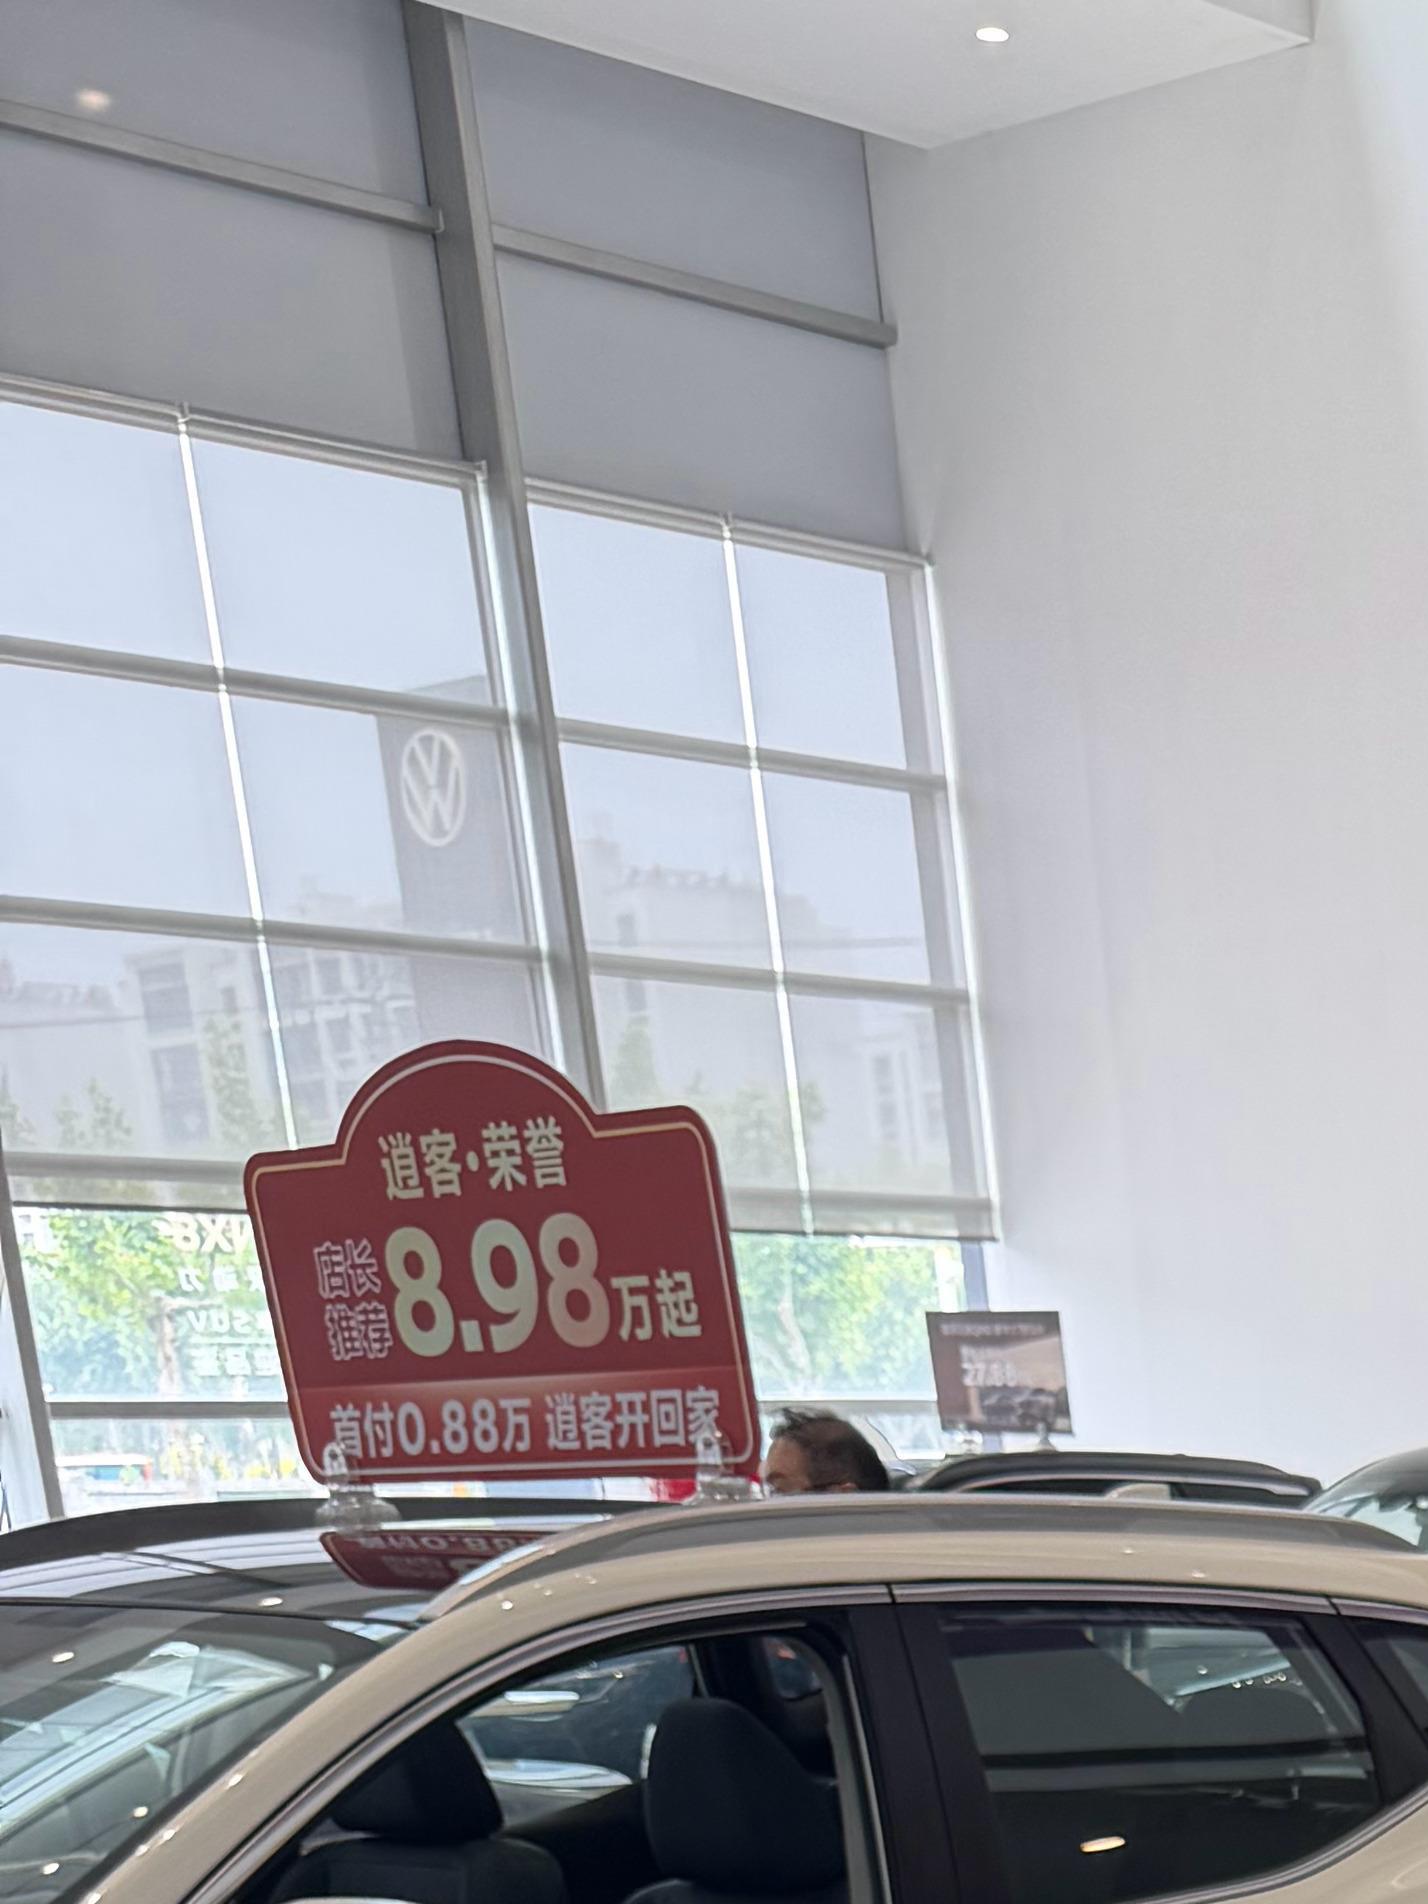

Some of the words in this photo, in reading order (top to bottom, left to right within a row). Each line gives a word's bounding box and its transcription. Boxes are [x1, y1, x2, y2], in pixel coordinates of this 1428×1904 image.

[378, 1115, 567, 1200] 逍客·荣誉
[313, 1238, 382, 1299] 店长
[323, 1302, 394, 1361] 推荐
[330, 1397, 531, 1459] 首付0.88万
[545, 1385, 721, 1453] 逍客开回家
